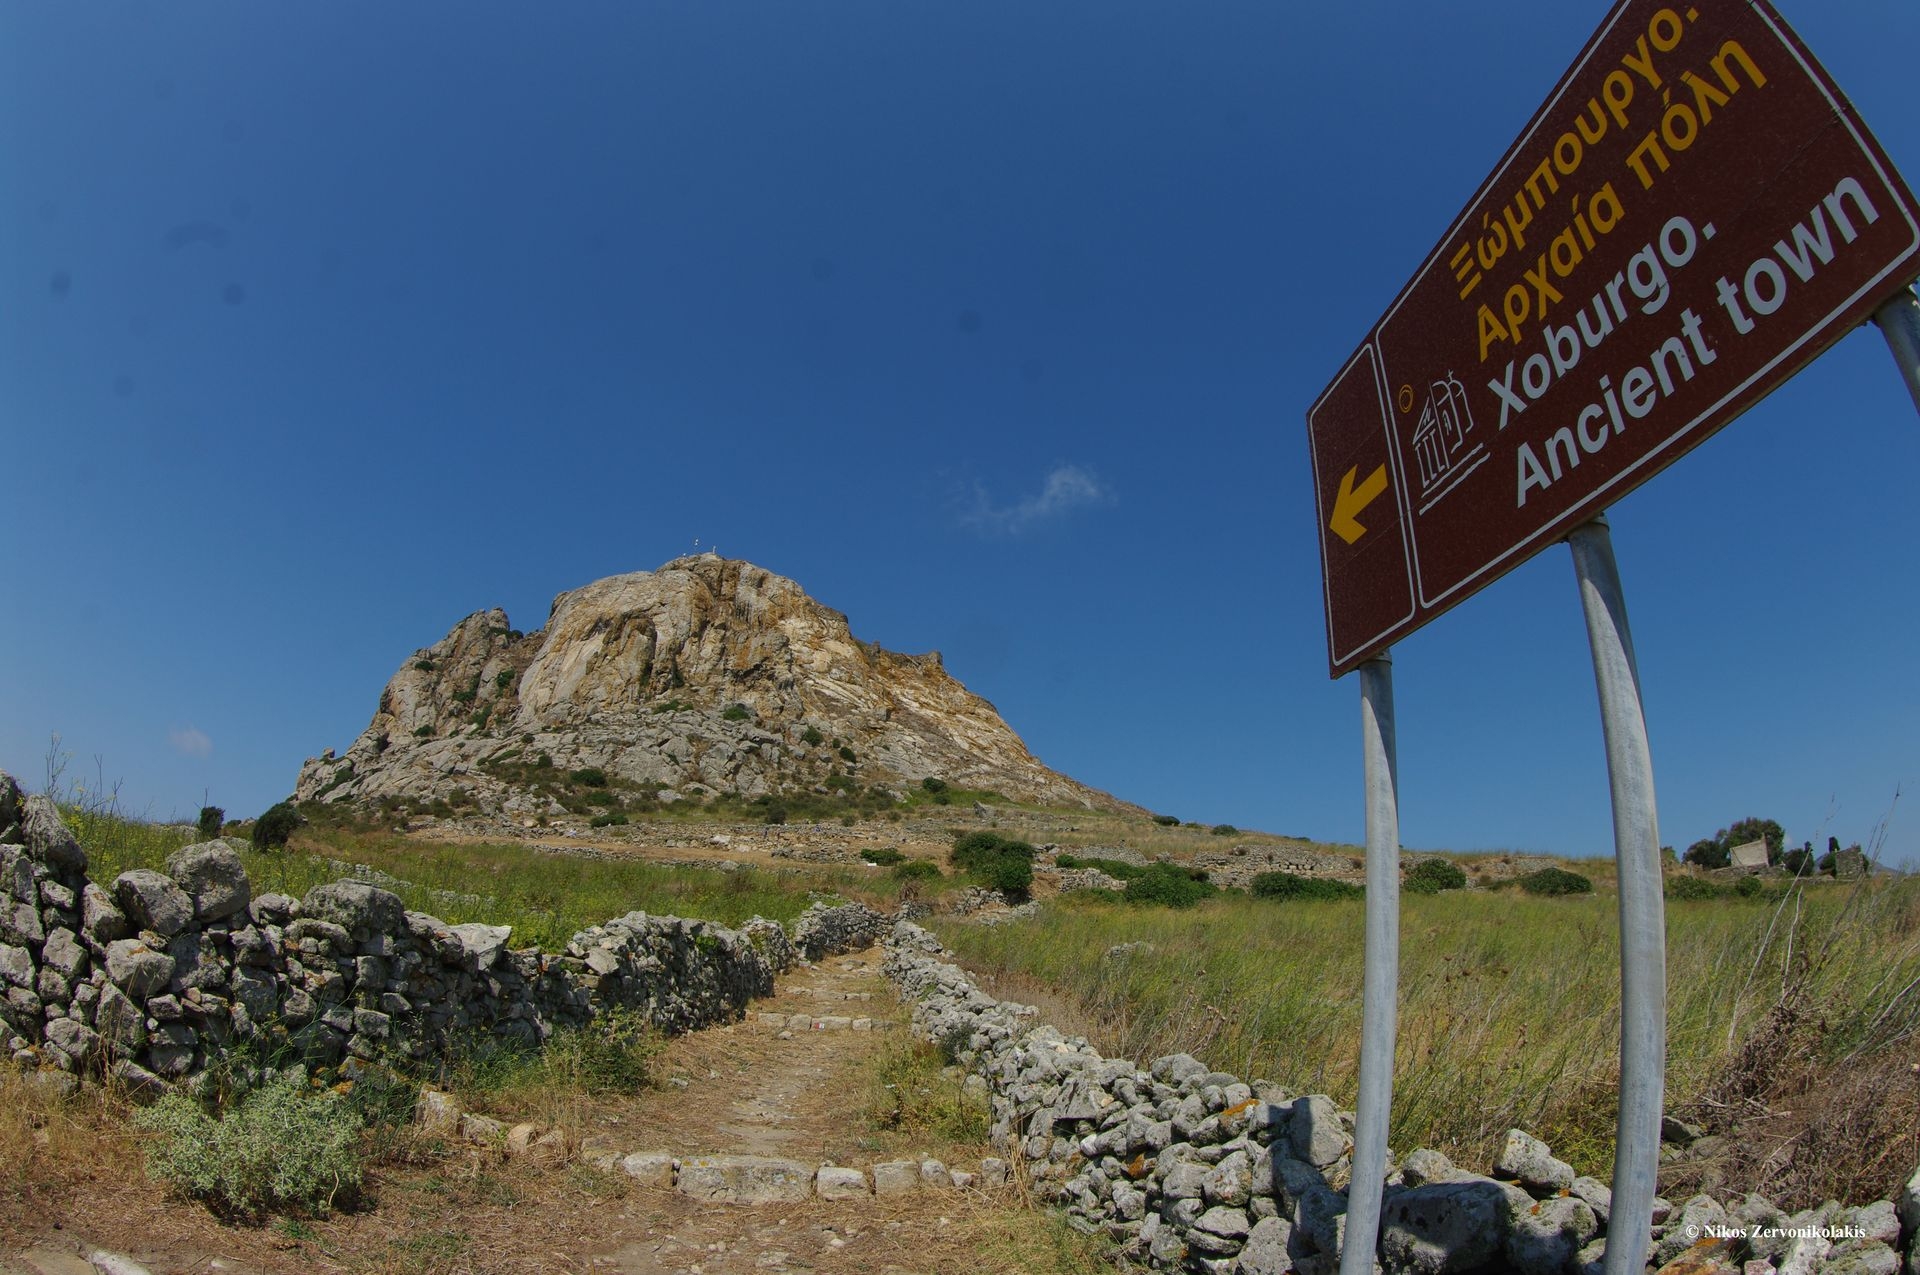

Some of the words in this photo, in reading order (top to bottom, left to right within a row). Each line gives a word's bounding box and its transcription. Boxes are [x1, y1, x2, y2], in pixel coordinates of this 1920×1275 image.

[1450, 8, 1699, 300] Ξώμπουργο.
[1477, 182, 1625, 363] Αρχαία
[1626, 40, 1767, 190] πόλη
[1488, 216, 1717, 430] Xoburgo.
[1516, 308, 1717, 507] Ancient
[1716, 176, 1879, 335] town
